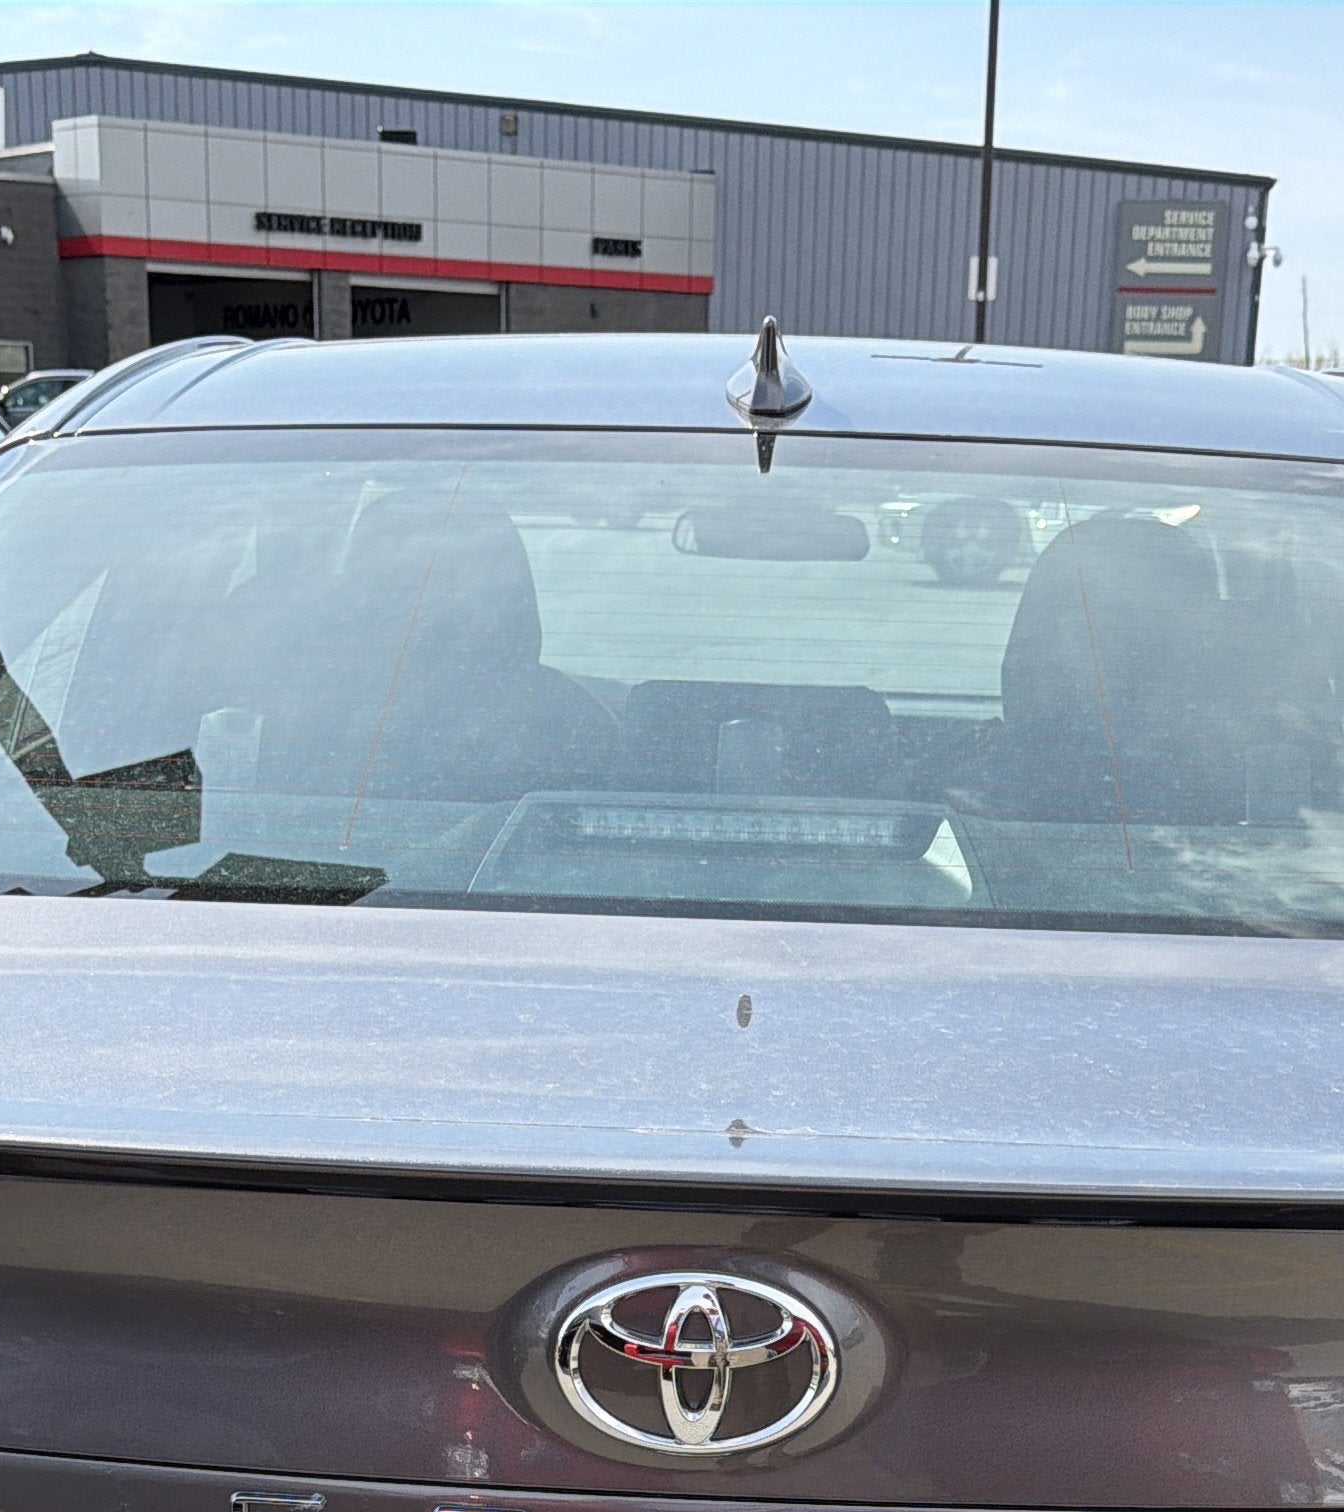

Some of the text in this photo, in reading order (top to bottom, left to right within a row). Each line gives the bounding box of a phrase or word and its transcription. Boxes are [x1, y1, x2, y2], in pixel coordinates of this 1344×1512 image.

[255, 212, 326, 234] SERVICE
[1164, 209, 1216, 225] SERVICE
[1132, 224, 1215, 241] DEPARTMENT
[1147, 242, 1213, 258] ENTRANCE
[1125, 305, 1194, 320] BODY SHOP
[1124, 320, 1186, 336] ENTRANCE
